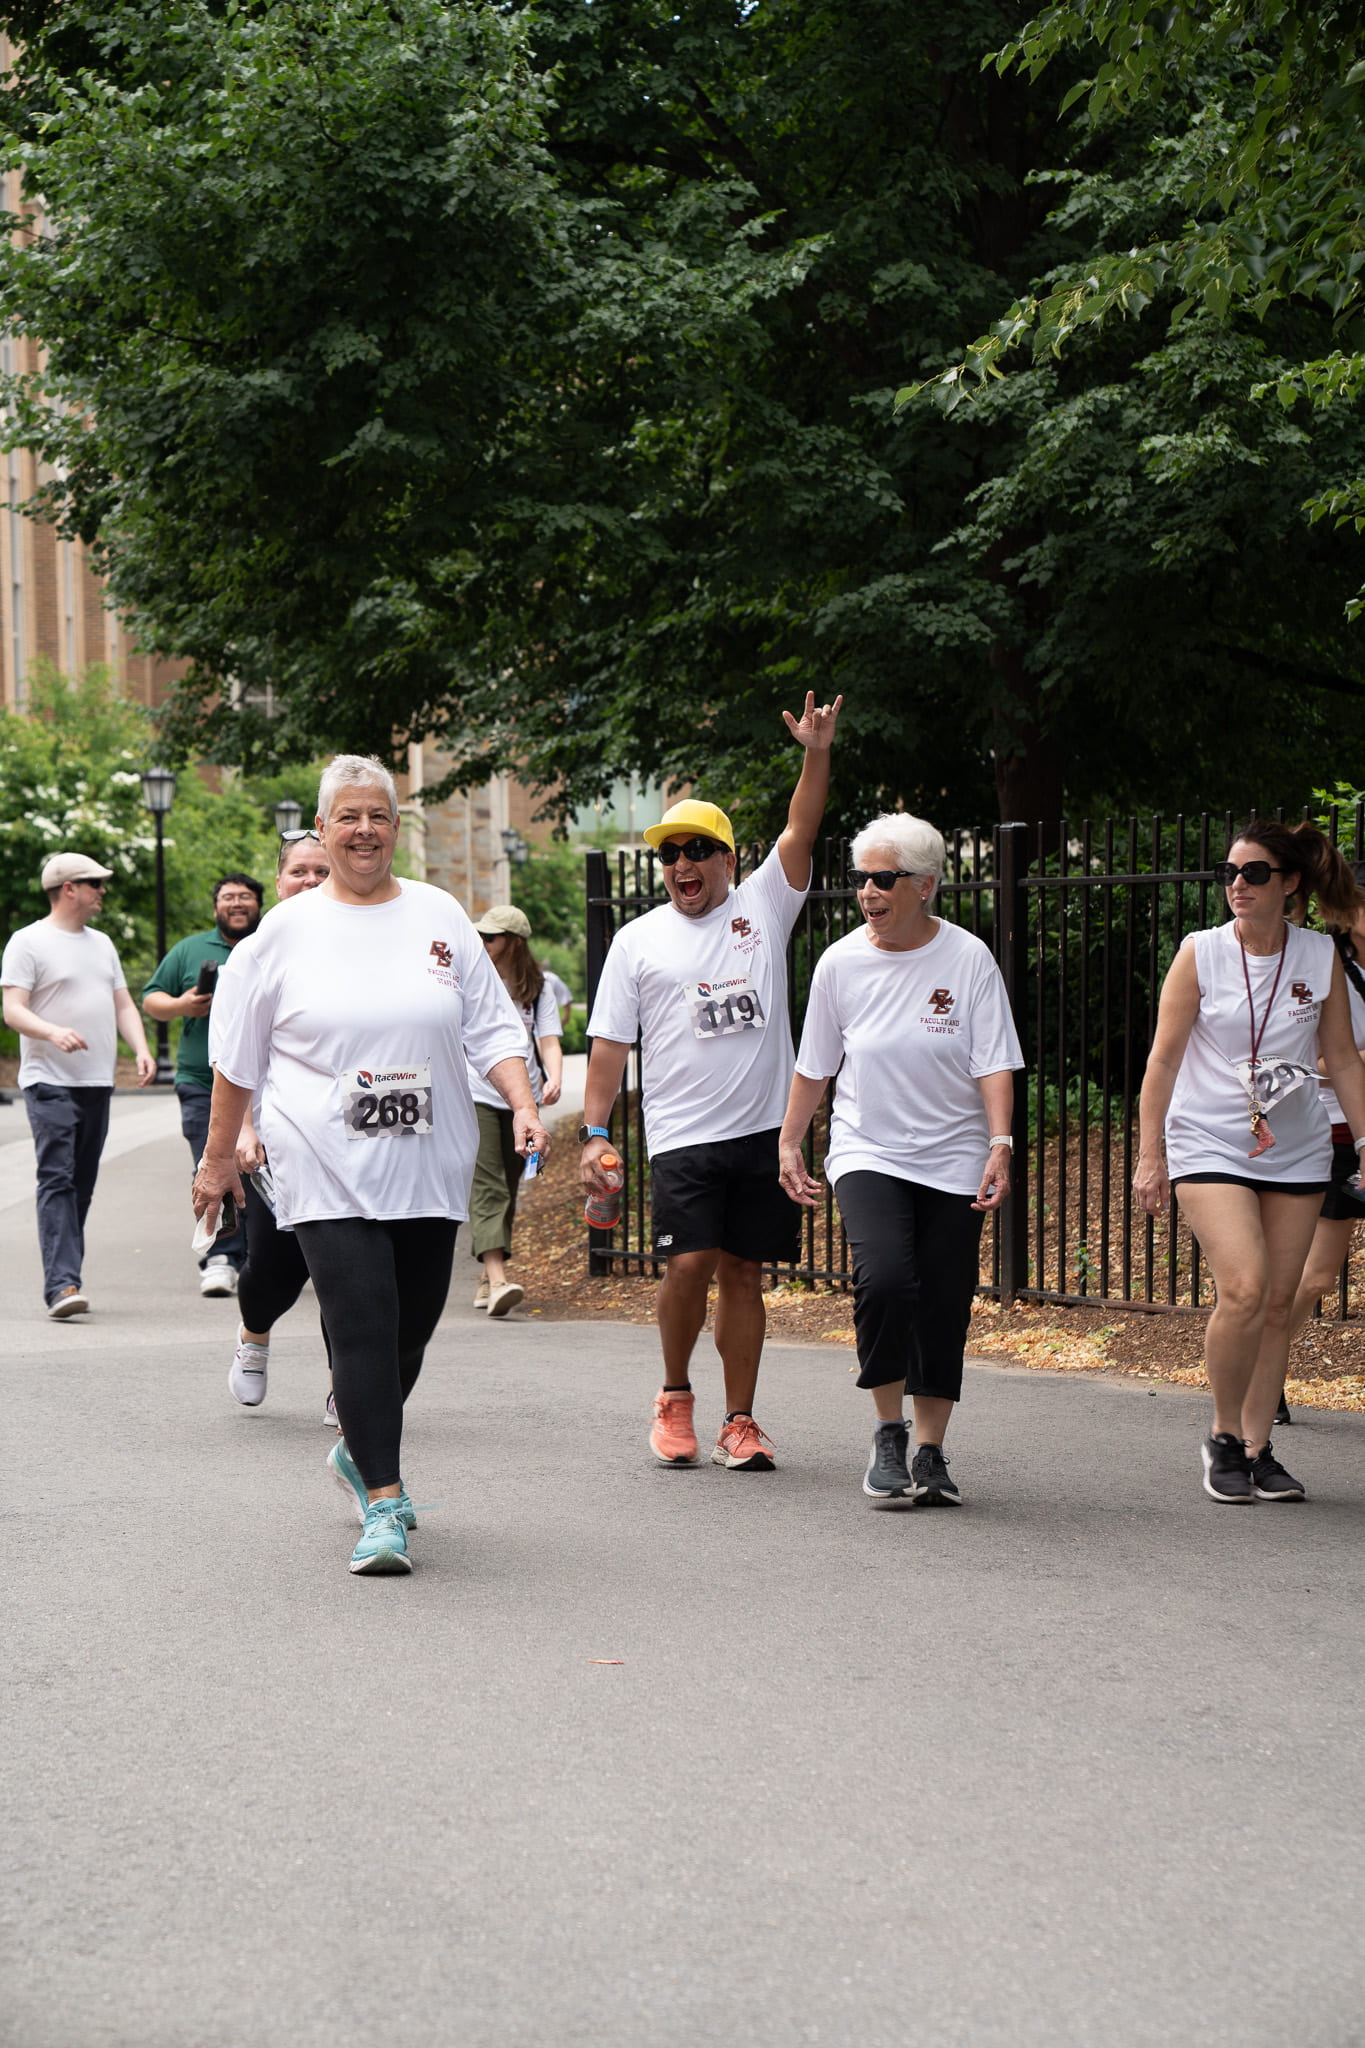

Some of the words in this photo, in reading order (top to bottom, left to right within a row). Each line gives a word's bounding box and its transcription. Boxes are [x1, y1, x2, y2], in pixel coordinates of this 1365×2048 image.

[712, 978, 747, 991] RaceWire
[702, 995, 755, 1028] 119
[926, 1026, 947, 1034] STAFF
[374, 1072, 417, 1083] RaceWire
[358, 1094, 420, 1129] 268
